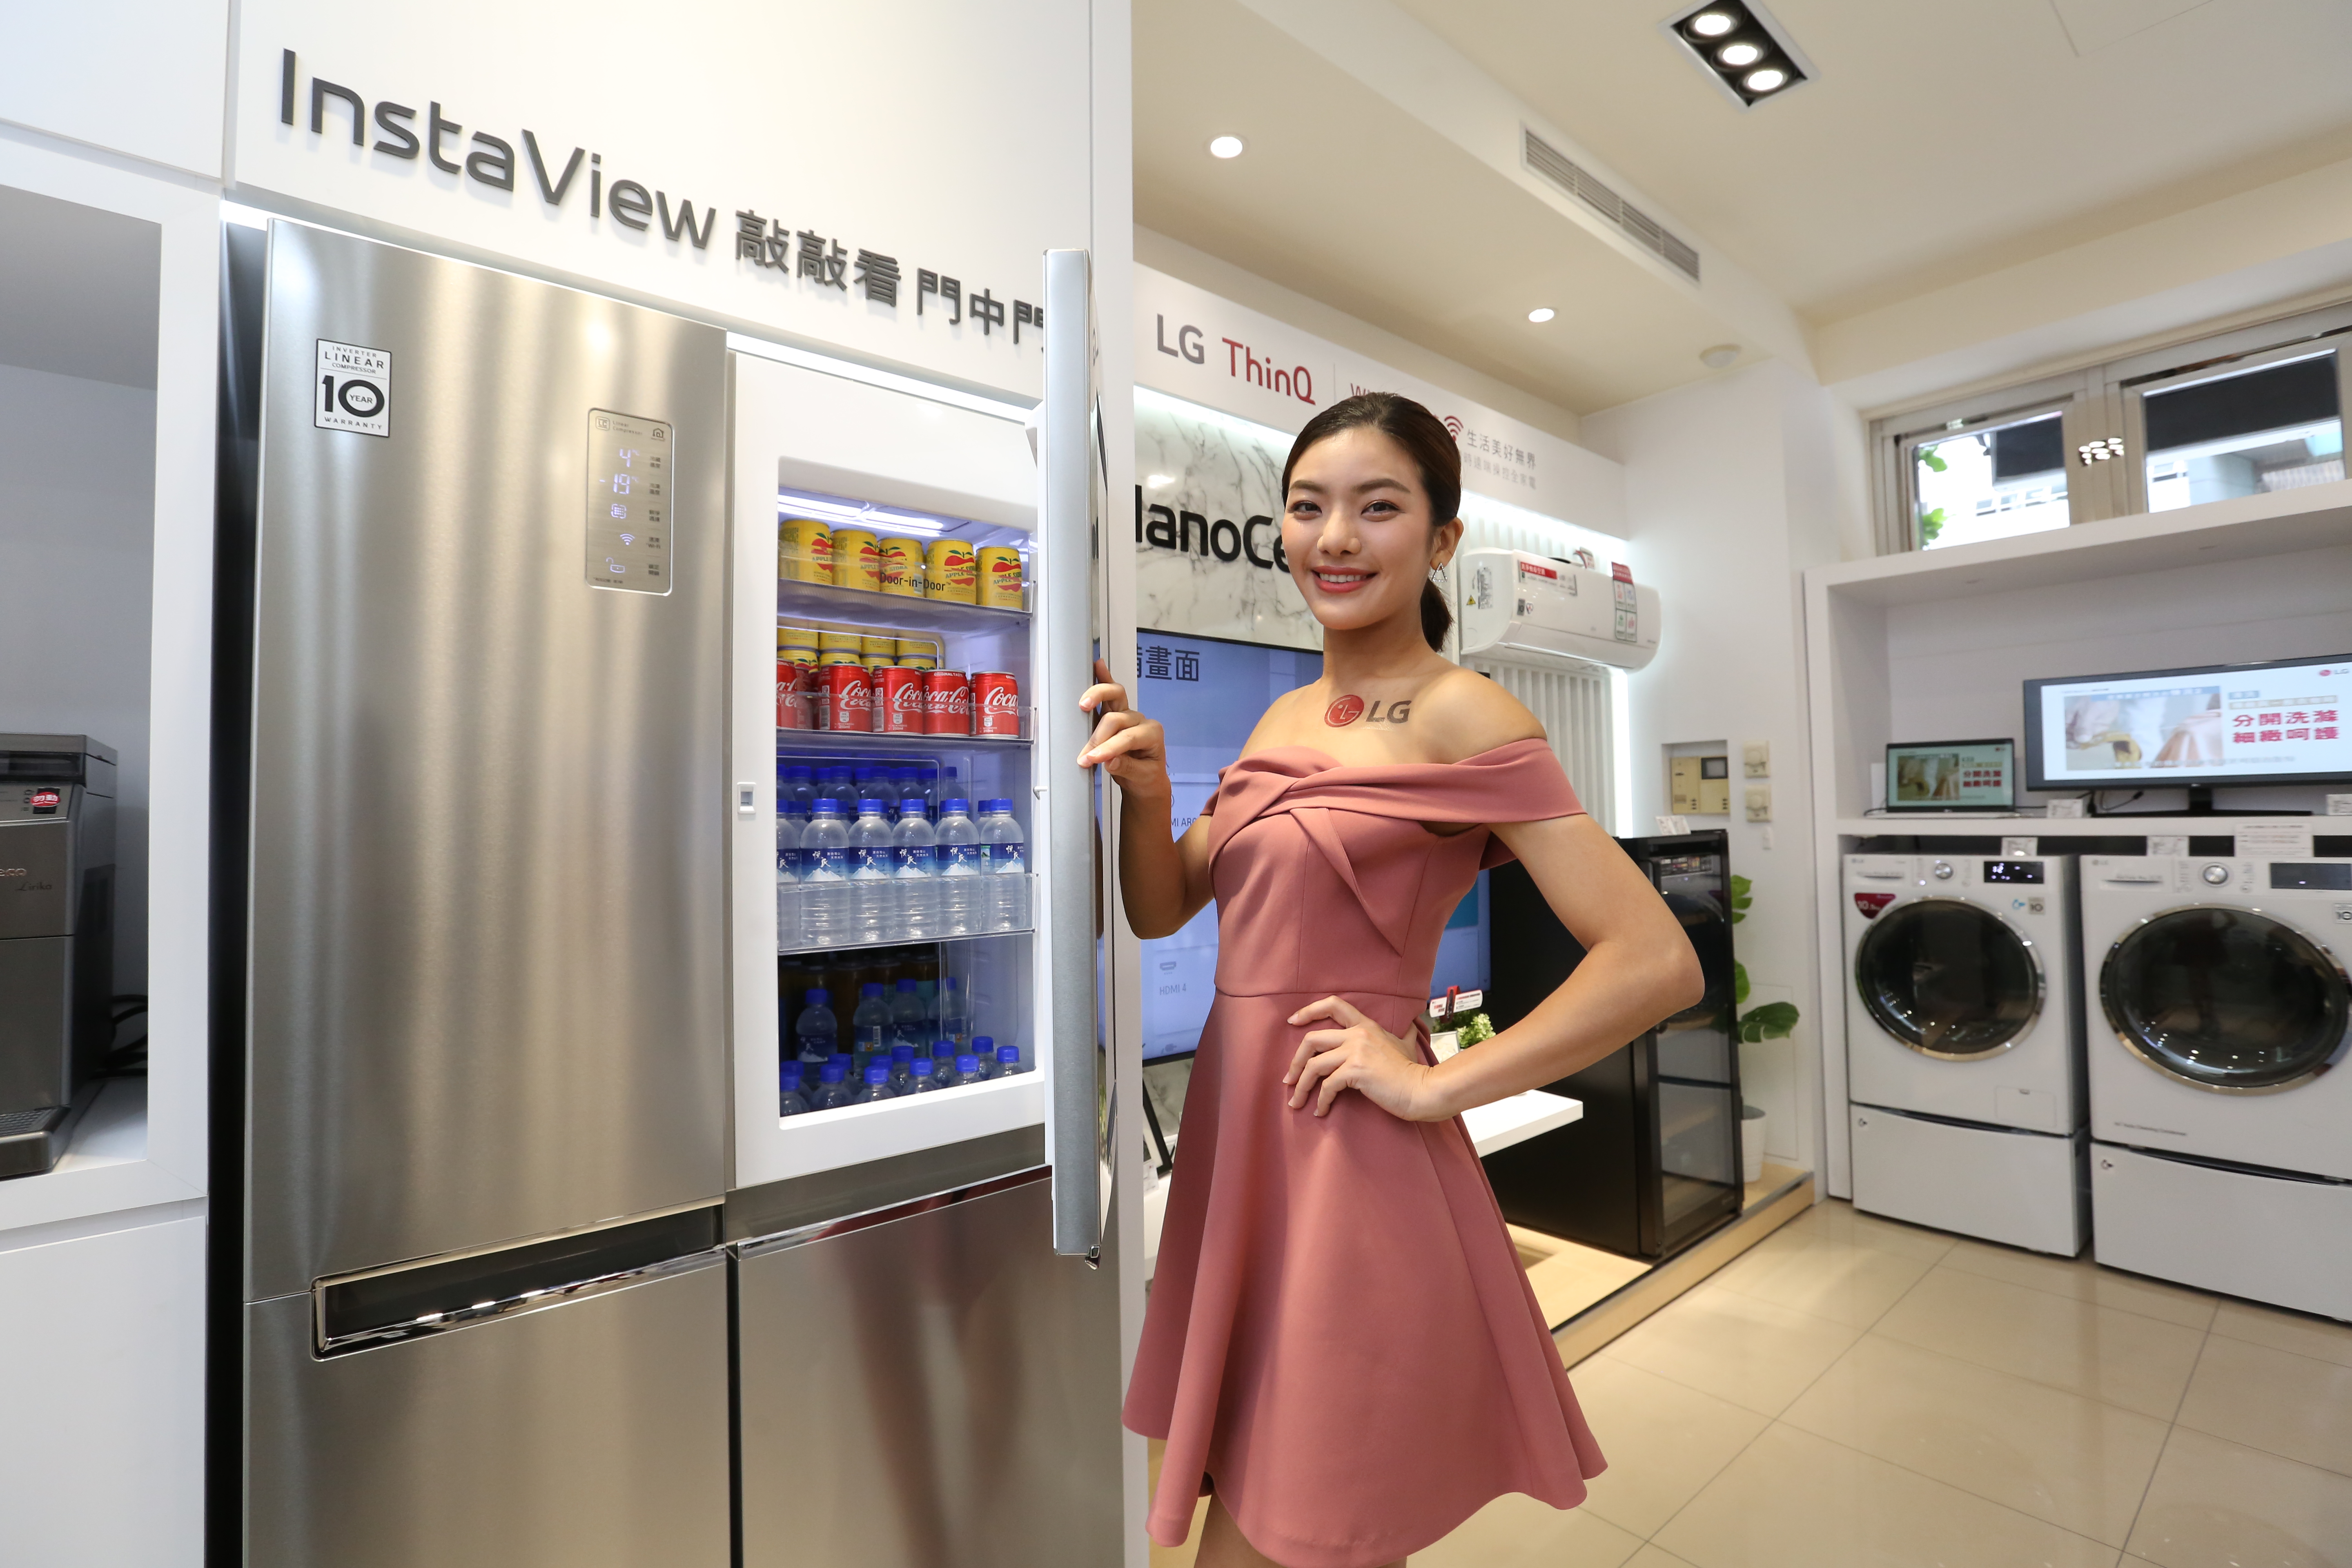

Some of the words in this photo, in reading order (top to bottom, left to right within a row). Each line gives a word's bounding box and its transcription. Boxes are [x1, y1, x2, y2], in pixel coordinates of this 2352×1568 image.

[281, 48, 716, 249] InstaView
[735, 209, 901, 307] 敲敲看
[917, 267, 1044, 352] 門中門
[325, 351, 384, 369] LINEAR
[332, 345, 377, 358] INVERTER
[1157, 314, 1205, 365] LG
[1222, 337, 1316, 405] ThinQ
[332, 362, 376, 374] COMPRESSOR
[322, 375, 385, 417] 10
[350, 394, 373, 404] YEAR
[324, 416, 383, 430] WARRANTY
[619, 448, 631, 468] 4
[1467, 429, 1536, 470] 生活美好無界
[1366, 700, 1412, 724] LG
[2232, 710, 2339, 727] 分開洗滌
[33, 794, 58, 802] 勿動
[16, 881, 53, 891] Lirika
[1160, 984, 1180, 996] HDMI
